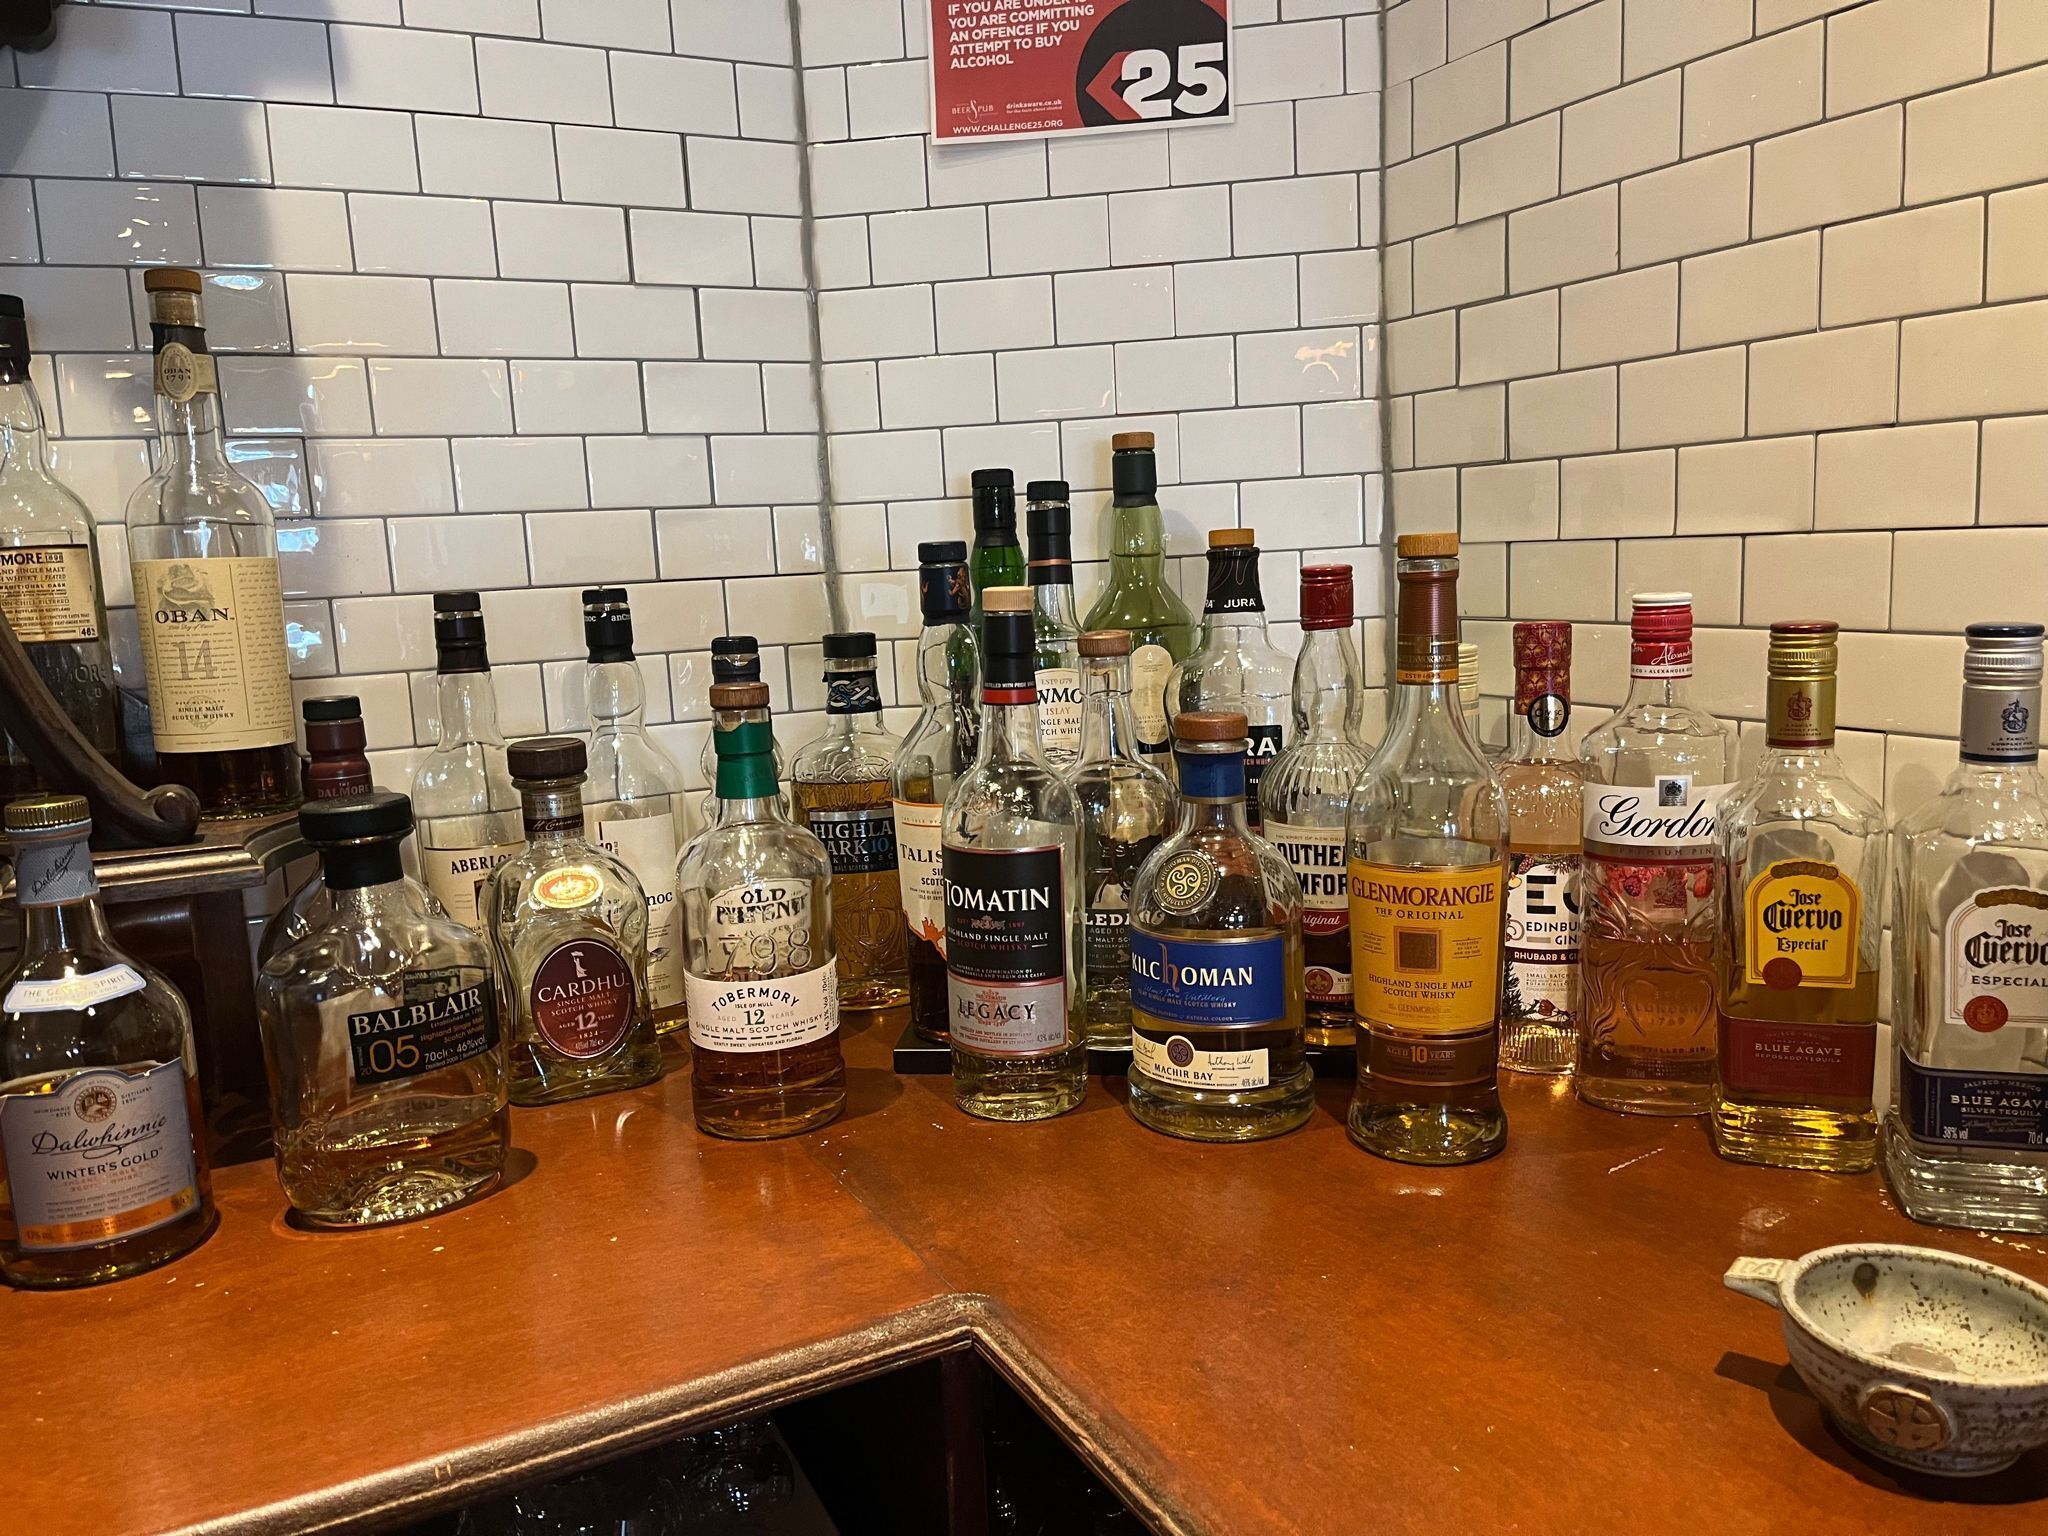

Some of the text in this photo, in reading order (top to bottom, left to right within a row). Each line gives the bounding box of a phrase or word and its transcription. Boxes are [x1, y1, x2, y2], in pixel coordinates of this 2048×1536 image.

[948, 4, 960, 15] IF
[963, 1, 990, 13] YOU
[994, 0, 1021, 11] ARE
[949, 4, 1094, 29] YOU ARE COMMITTING
[950, 20, 1080, 42] AN OFFENCE IF YOU
[950, 35, 1062, 56] ATTEMPT TO BUY
[950, 54, 1014, 69] ALCOHOL
[1121, 42, 1227, 119] 25
[951, 105, 994, 115] BEER PUB
[953, 120, 1063, 134] WWW.CHALLENGE25.ORG
[0, 552, 43, 566] MORE
[1223, 598, 1256, 609] JURA
[155, 607, 230, 624] OBAN
[173, 639, 218, 680] 14
[1046, 707, 1070, 716] ISLAY
[318, 784, 370, 798] DALMORE
[900, 843, 943, 864] TALIS
[1270, 842, 1346, 867] OUTHE
[451, 853, 512, 875] ABERLO
[741, 888, 786, 904] OLD
[945, 878, 1050, 911] TOMATIN
[1352, 876, 1494, 906] GLENMORANGIE
[1788, 888, 1822, 908] Jose
[1085, 913, 1130, 926] LED
[1376, 907, 1464, 920] THE ORIGINAL
[1763, 900, 1842, 933] Cuervo
[948, 926, 1048, 943] HIGHLAND SINGLE MALT
[1995, 919, 2032, 939] Jose
[958, 940, 1028, 951] SCOTCH WHISKY
[1555, 935, 1577, 945] GIN
[1776, 937, 1828, 953] Especial
[1514, 951, 1557, 961] RHUBARB
[94, 974, 125, 988] SPIRIT
[538, 972, 625, 1003] CARDHU
[1369, 973, 1474, 990] HIGHLAND SINGLE MALT
[1971, 975, 2048, 988] ESPECIAL
[557, 992, 610, 1008] SINGLE MALT
[712, 987, 799, 1012] TOBERMORY
[1383, 986, 1456, 999] SCOTCH WHISKY
[551, 998, 617, 1016] SCOTCH WHISKY
[958, 998, 1035, 1020] LEGACY
[1166, 997, 1182, 1006] MALT
[352, 988, 482, 1036] BALBLAIR
[743, 1009, 766, 1026] 12
[771, 1011, 794, 1020] YEARS
[575, 1011, 598, 1031] 12
[695, 1021, 720, 1033] SINGLE
[749, 1023, 789, 1034] SCOTCH
[793, 1014, 823, 1028] WHISKY
[579, 1030, 599, 1040] 1824
[369, 1034, 420, 1073] 05
[1386, 1045, 1456, 1063] AGED 10 YEARS
[1755, 1043, 1842, 1056] BLUE AGAVE
[1755, 1053, 1802, 1061] REPOSADO
[1154, 1063, 1214, 1081] MACHIR BAY
[1963, 1079, 2000, 1089] JALISCO
[1950, 1094, 1993, 1106] BLUE
[1999, 1108, 2042, 1117] TEQUILA
[32, 1114, 167, 1155] Dalwhinnie
[47, 1149, 159, 1180] WINTER'S GOLD
